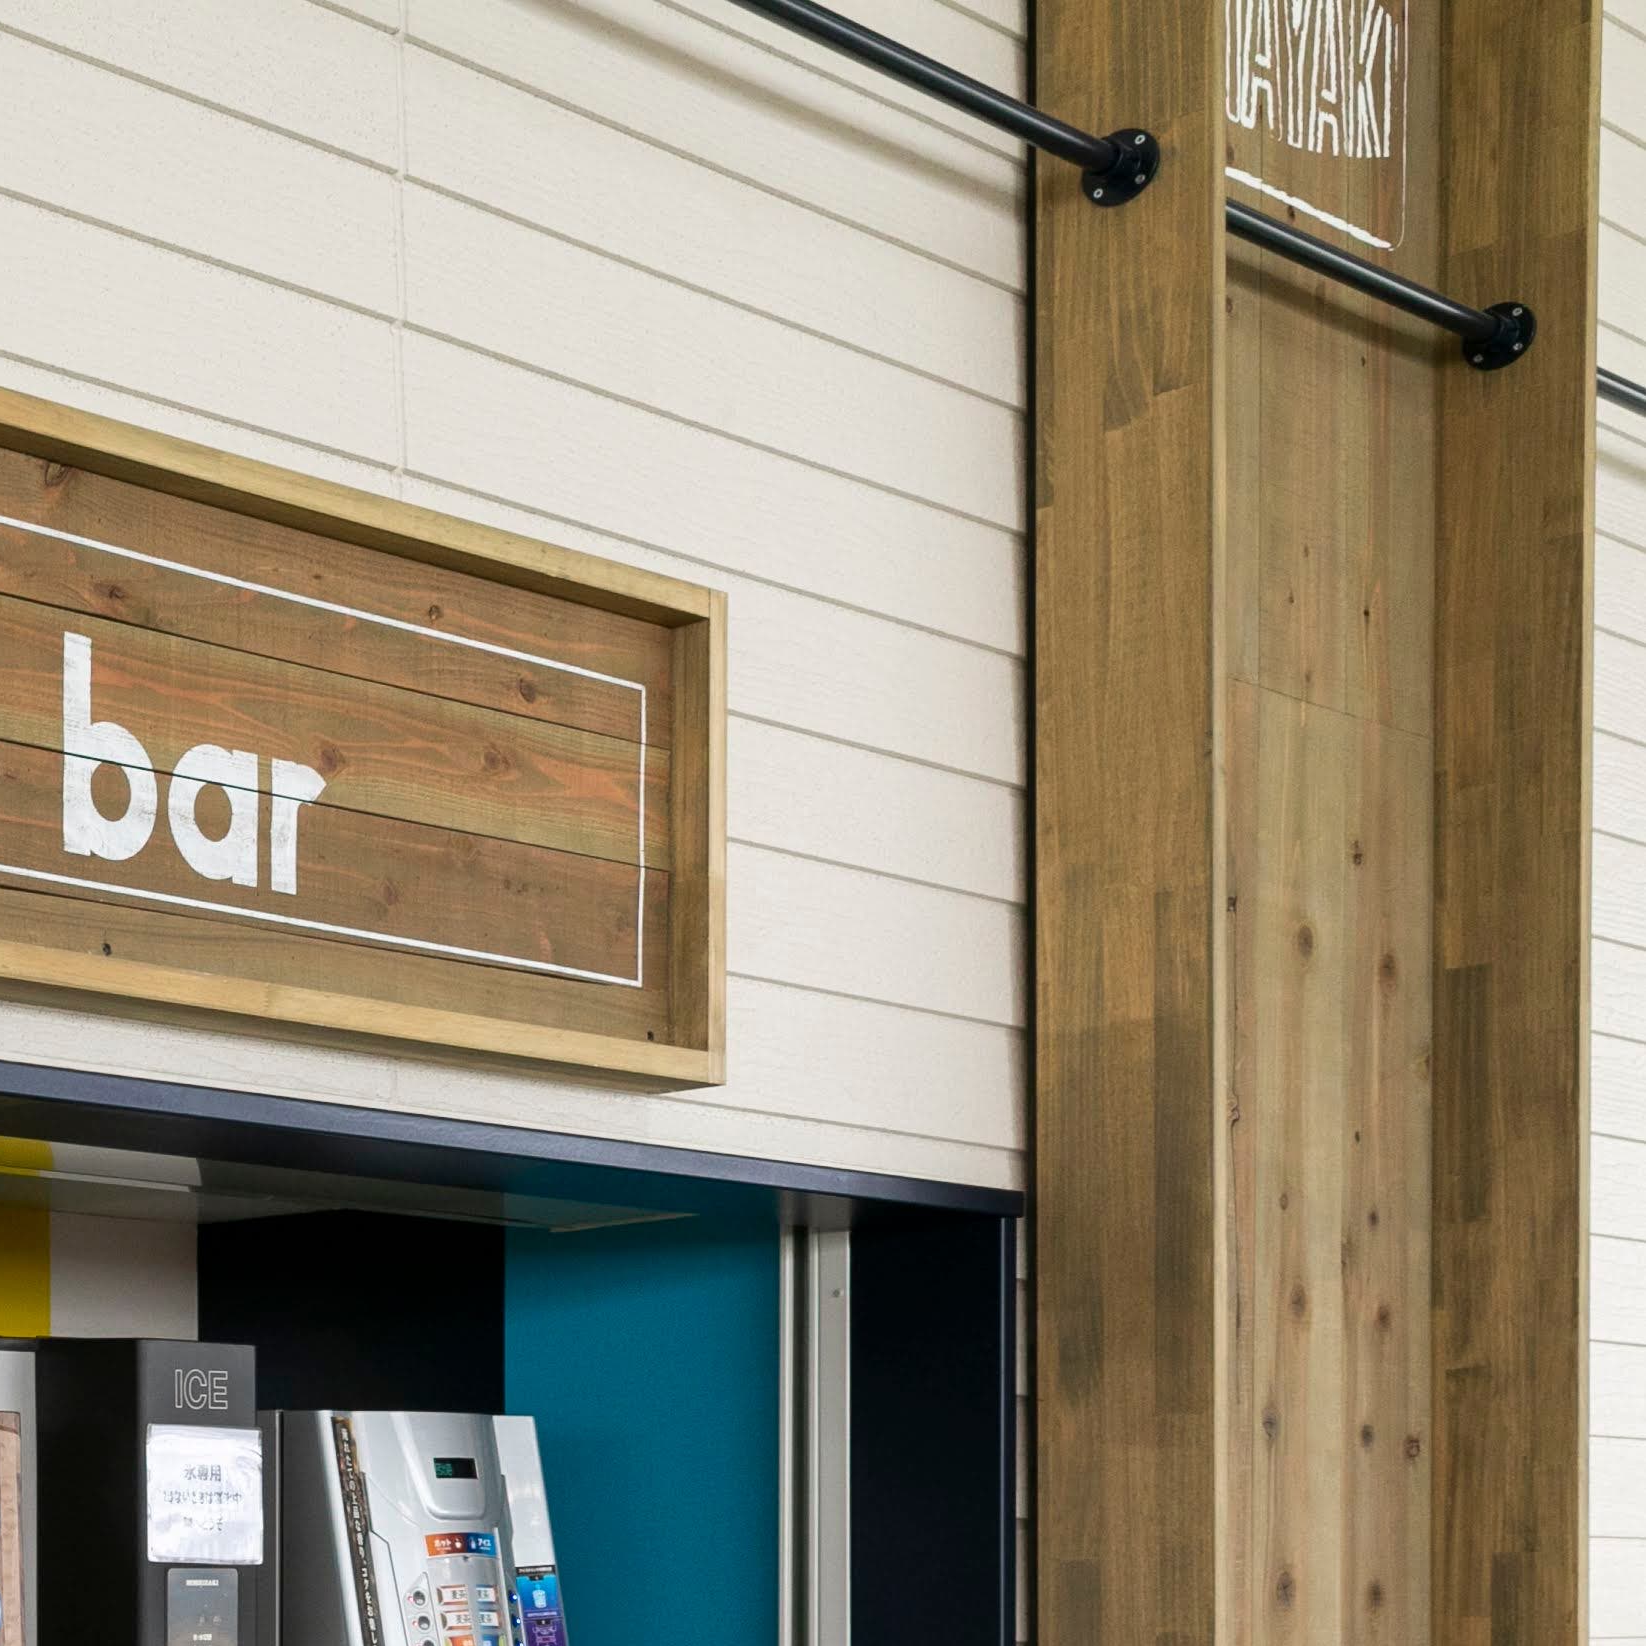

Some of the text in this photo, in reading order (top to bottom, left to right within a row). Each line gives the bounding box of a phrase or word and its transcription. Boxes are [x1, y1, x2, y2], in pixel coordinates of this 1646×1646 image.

[1225, 0, 1400, 159] AYAKI
[61, 630, 328, 896] bar
[174, 1368, 229, 1410] ICE
[434, 1538, 452, 1548] ホット
